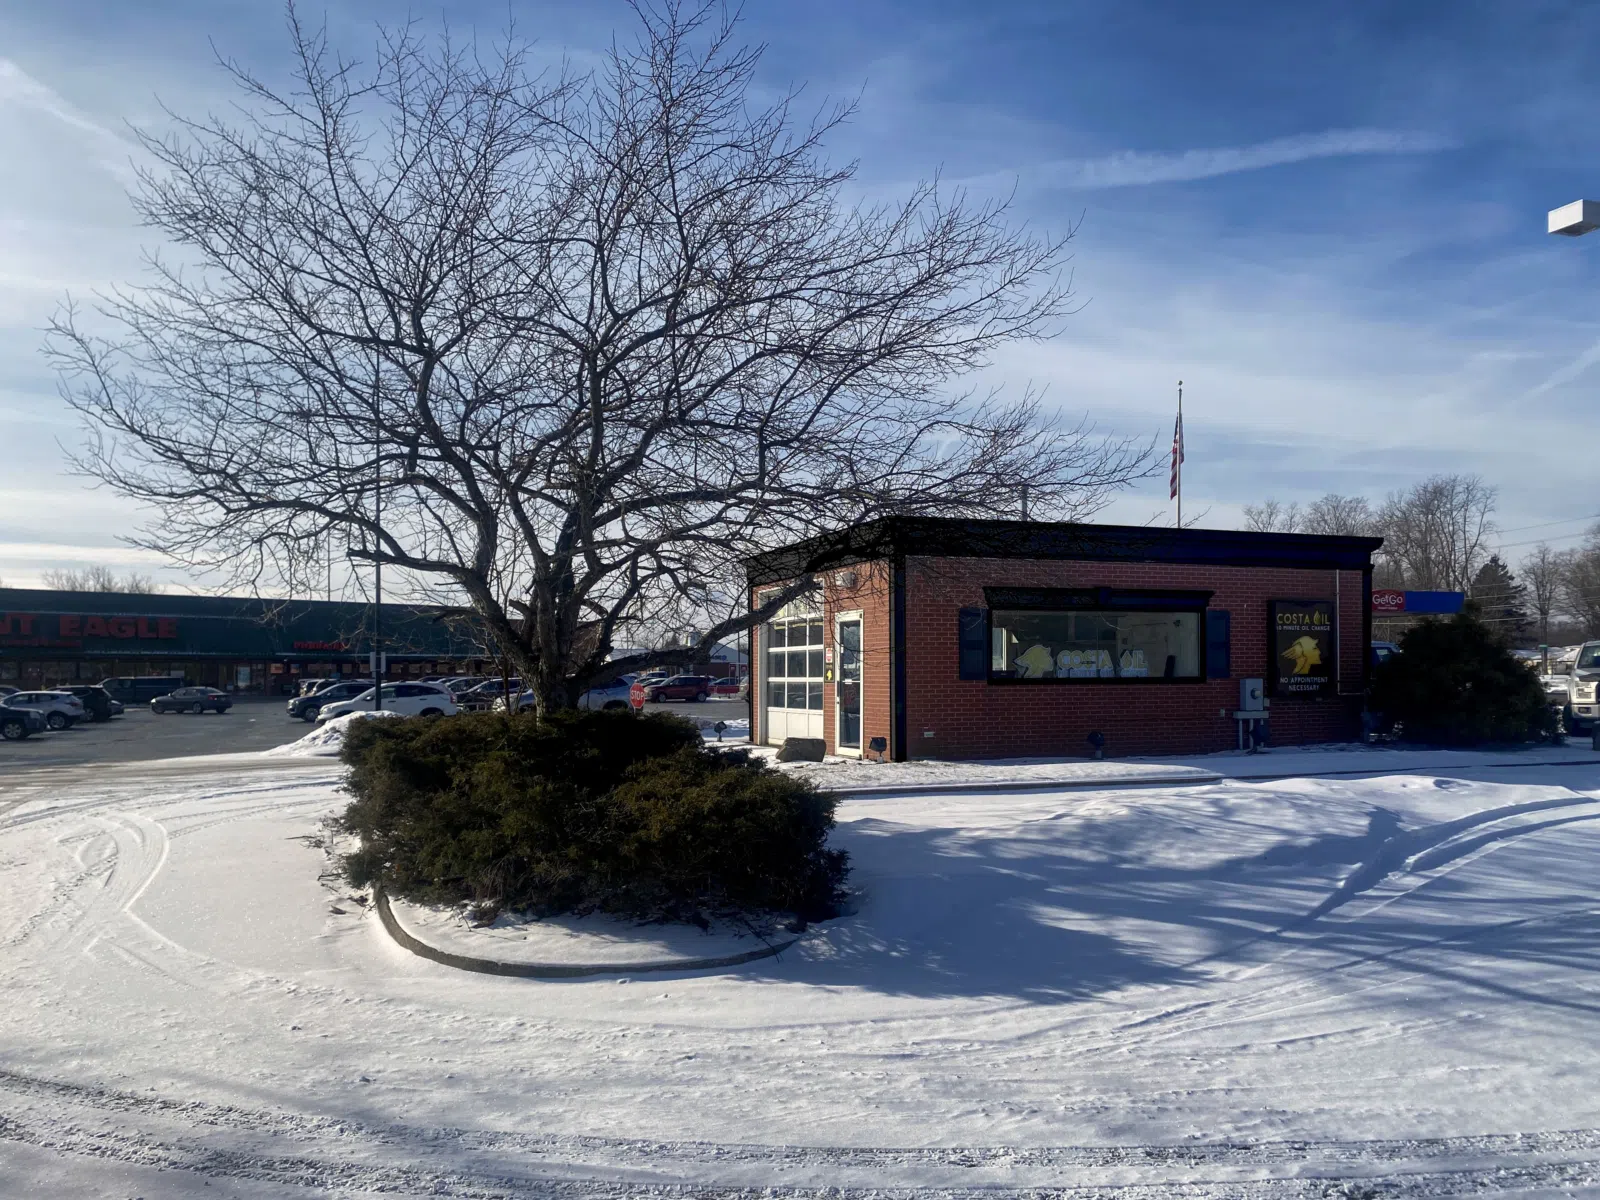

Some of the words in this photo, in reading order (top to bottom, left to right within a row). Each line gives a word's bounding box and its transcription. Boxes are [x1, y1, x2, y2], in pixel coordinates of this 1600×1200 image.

[1372, 594, 1403, 604] GetGo
[1277, 614, 1310, 624] COSTA
[59, 615, 178, 639] EAGLE
[1057, 650, 1113, 668] COSTA
[631, 690, 644, 700] STOP
